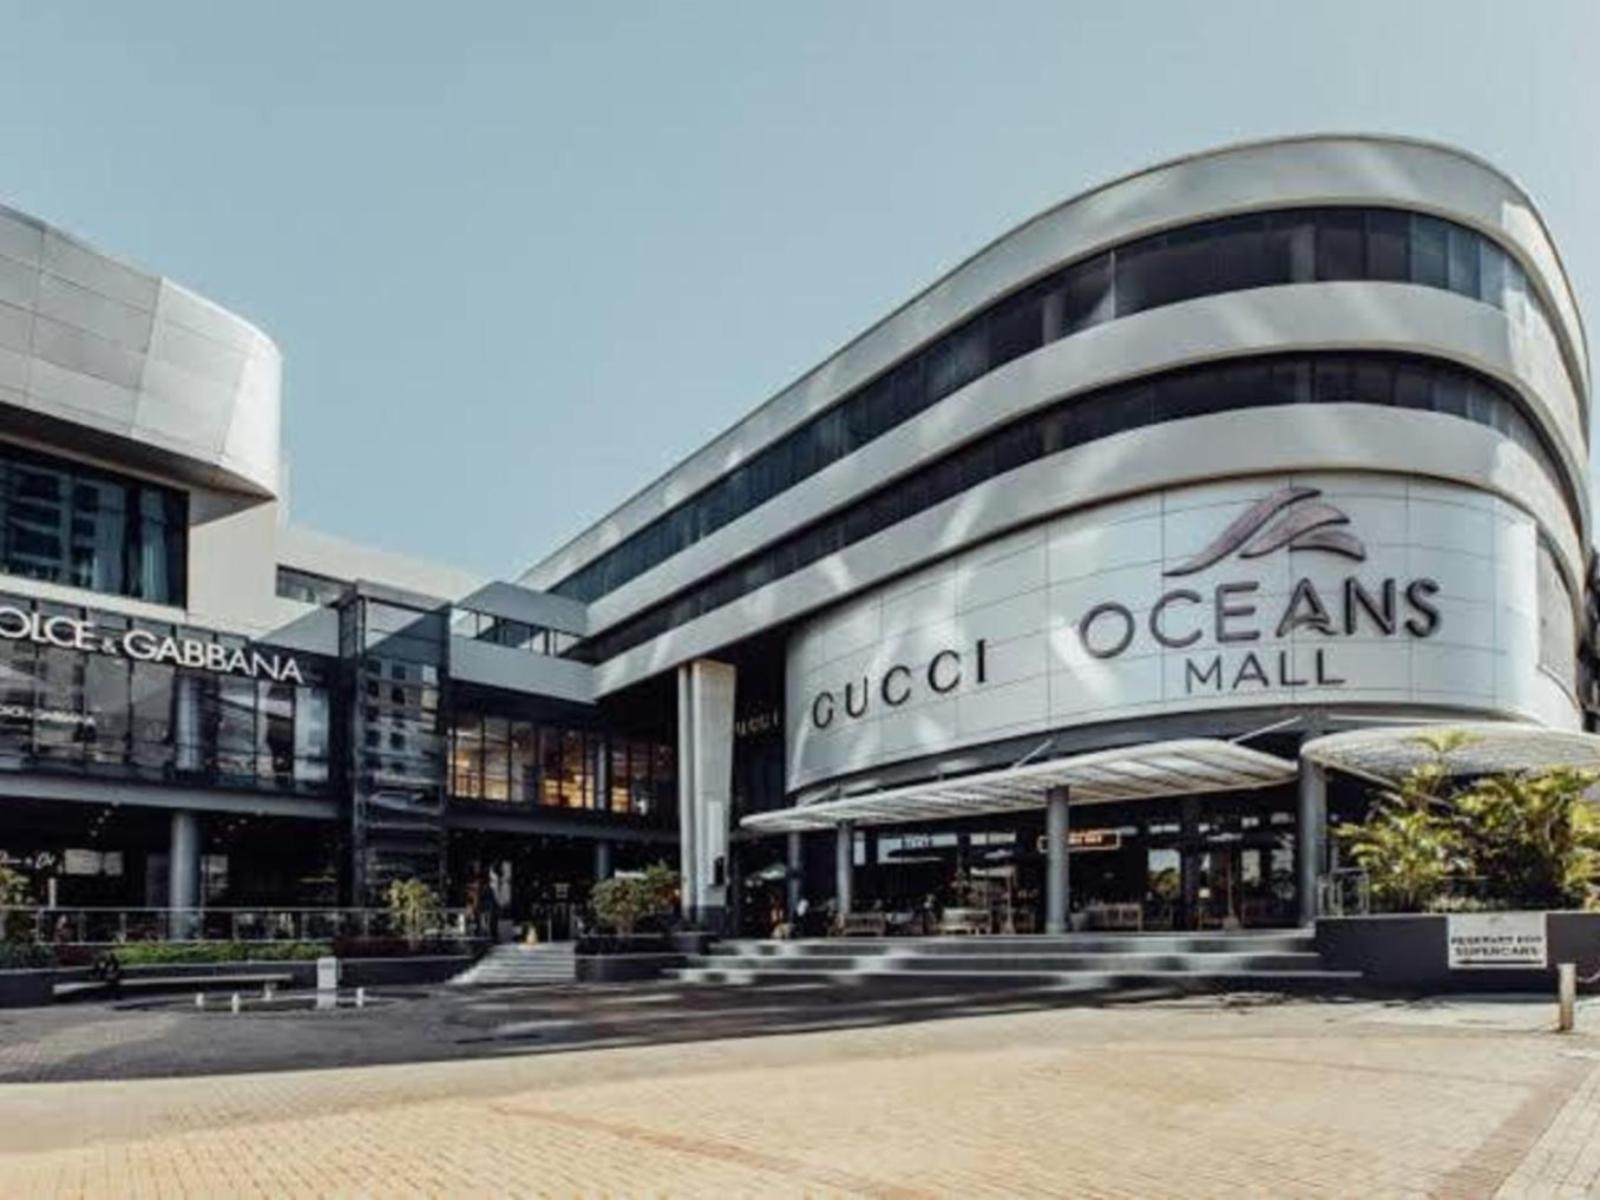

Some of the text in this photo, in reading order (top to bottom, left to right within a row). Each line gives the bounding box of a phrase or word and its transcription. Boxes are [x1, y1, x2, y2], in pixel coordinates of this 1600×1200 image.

[1079, 577, 1442, 660] OCEANS
[102, 637, 117, 655] &
[123, 629, 304, 684] GABBANA
[811, 638, 987, 730] GUCCI
[1184, 648, 1347, 694] MALL
